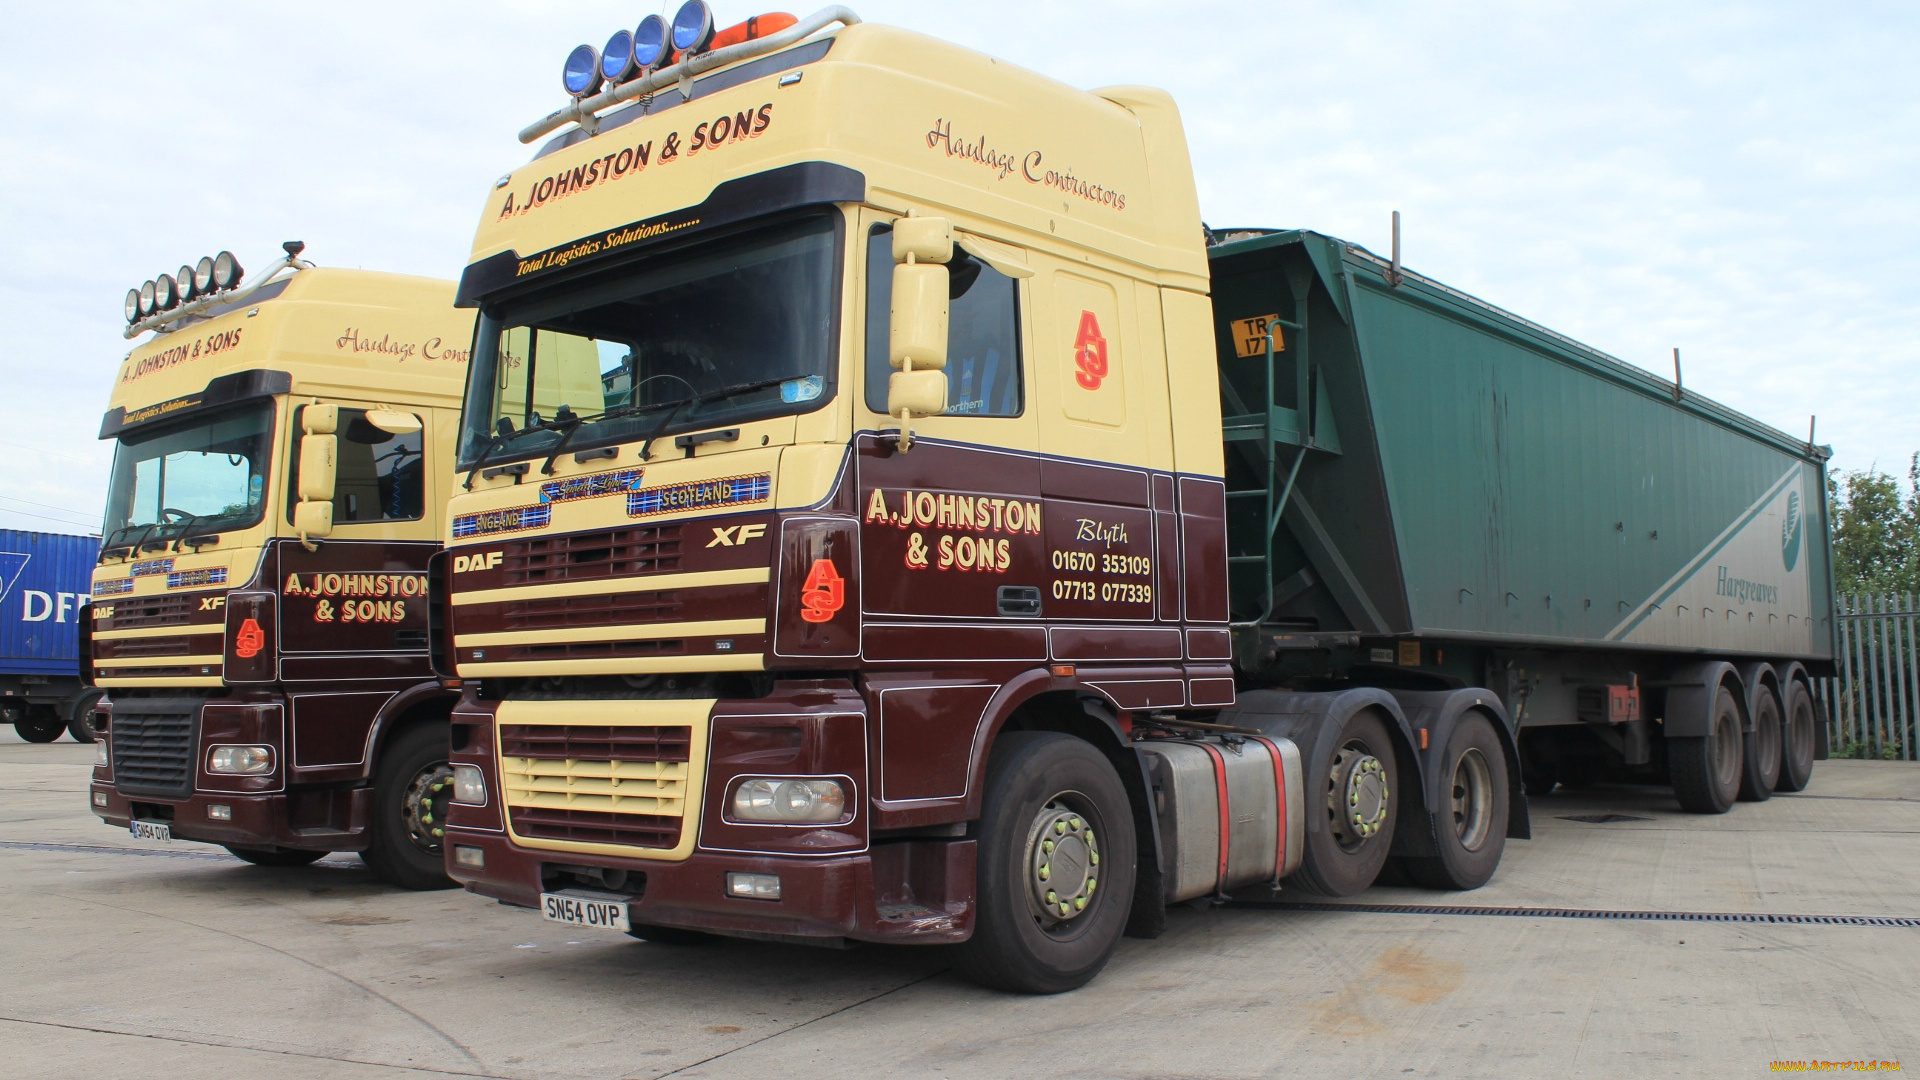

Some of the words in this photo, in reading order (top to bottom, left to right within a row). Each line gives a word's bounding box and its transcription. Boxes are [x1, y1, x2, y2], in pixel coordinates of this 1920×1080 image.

[521, 141, 652, 216] JOHNSTON
[657, 132, 681, 166] &
[687, 103, 773, 157] SONS
[926, 117, 1015, 181] Haulage
[1021, 150, 1126, 211] Contractors
[516, 251, 546, 277] Total
[546, 240, 600, 267] Logistics
[1244, 318, 1267, 335] TR
[191, 339, 202, 361] &
[203, 328, 242, 358] SONS
[336, 327, 415, 363] Haulage
[662, 484, 732, 507] SCOTLAND
[476, 512, 519, 530] ENGLAND
[1076, 518, 1128, 549] Blyth
[705, 523, 768, 548] XF
[453, 551, 503, 573] DAF
[904, 531, 931, 569] &
[937, 534, 1011, 572] SONS
[1052, 550, 1095, 572] 01670
[1102, 554, 1150, 575] 353109
[1052, 580, 1095, 601] 07713
[1102, 582, 1150, 603] 077339
[1716, 566, 1778, 605] Hargreaves
[93, 607, 114, 619] DAF
[199, 597, 225, 610] XF
[314, 600, 334, 622] &
[340, 600, 406, 623] SONS
[137, 824, 154, 839] SN54
[547, 897, 583, 923] SN54
[587, 903, 620, 927] OVP
